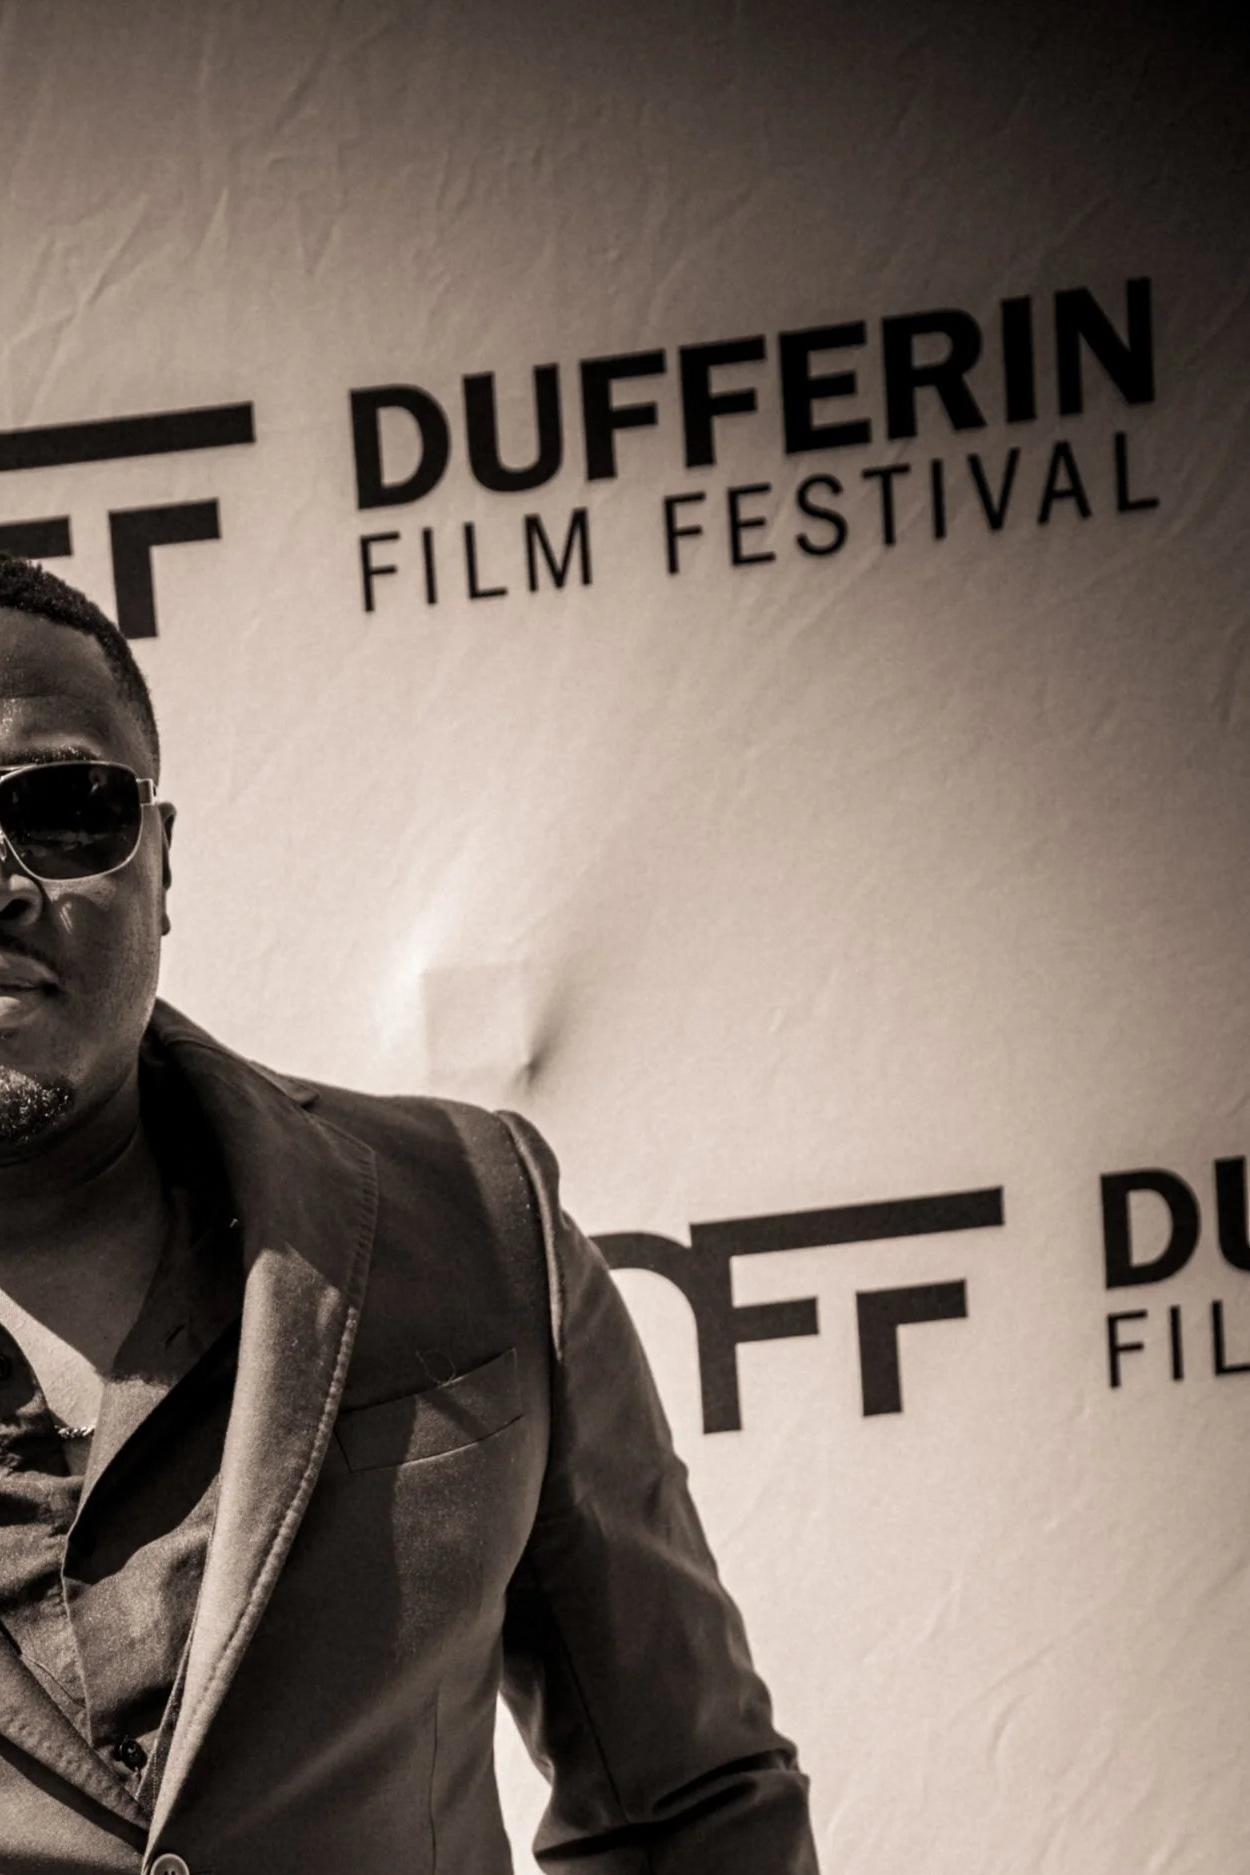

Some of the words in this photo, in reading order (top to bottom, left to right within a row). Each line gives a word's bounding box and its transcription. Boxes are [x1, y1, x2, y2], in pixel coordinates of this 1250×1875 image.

[350, 276, 1158, 511] DUFFERIN
[359, 508, 593, 613] FILM
[663, 430, 1161, 576] FESTIVAL
